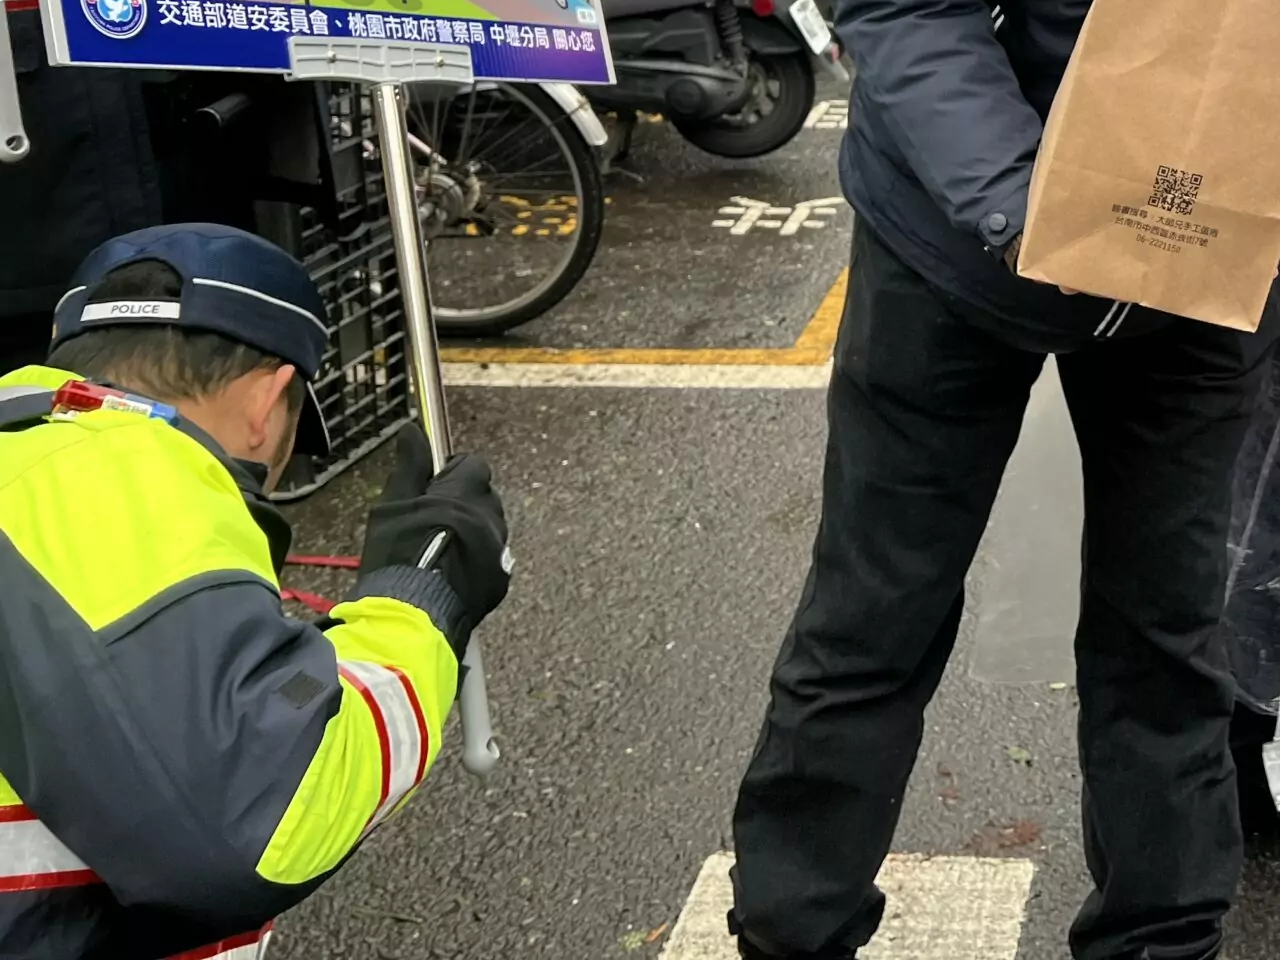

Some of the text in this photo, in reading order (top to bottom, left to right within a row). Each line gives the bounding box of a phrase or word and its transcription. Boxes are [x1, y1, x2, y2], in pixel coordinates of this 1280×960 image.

[490, 25, 550, 49] 中壢分局
[553, 29, 597, 53] 關心您
[110, 304, 161, 315] POLICE
